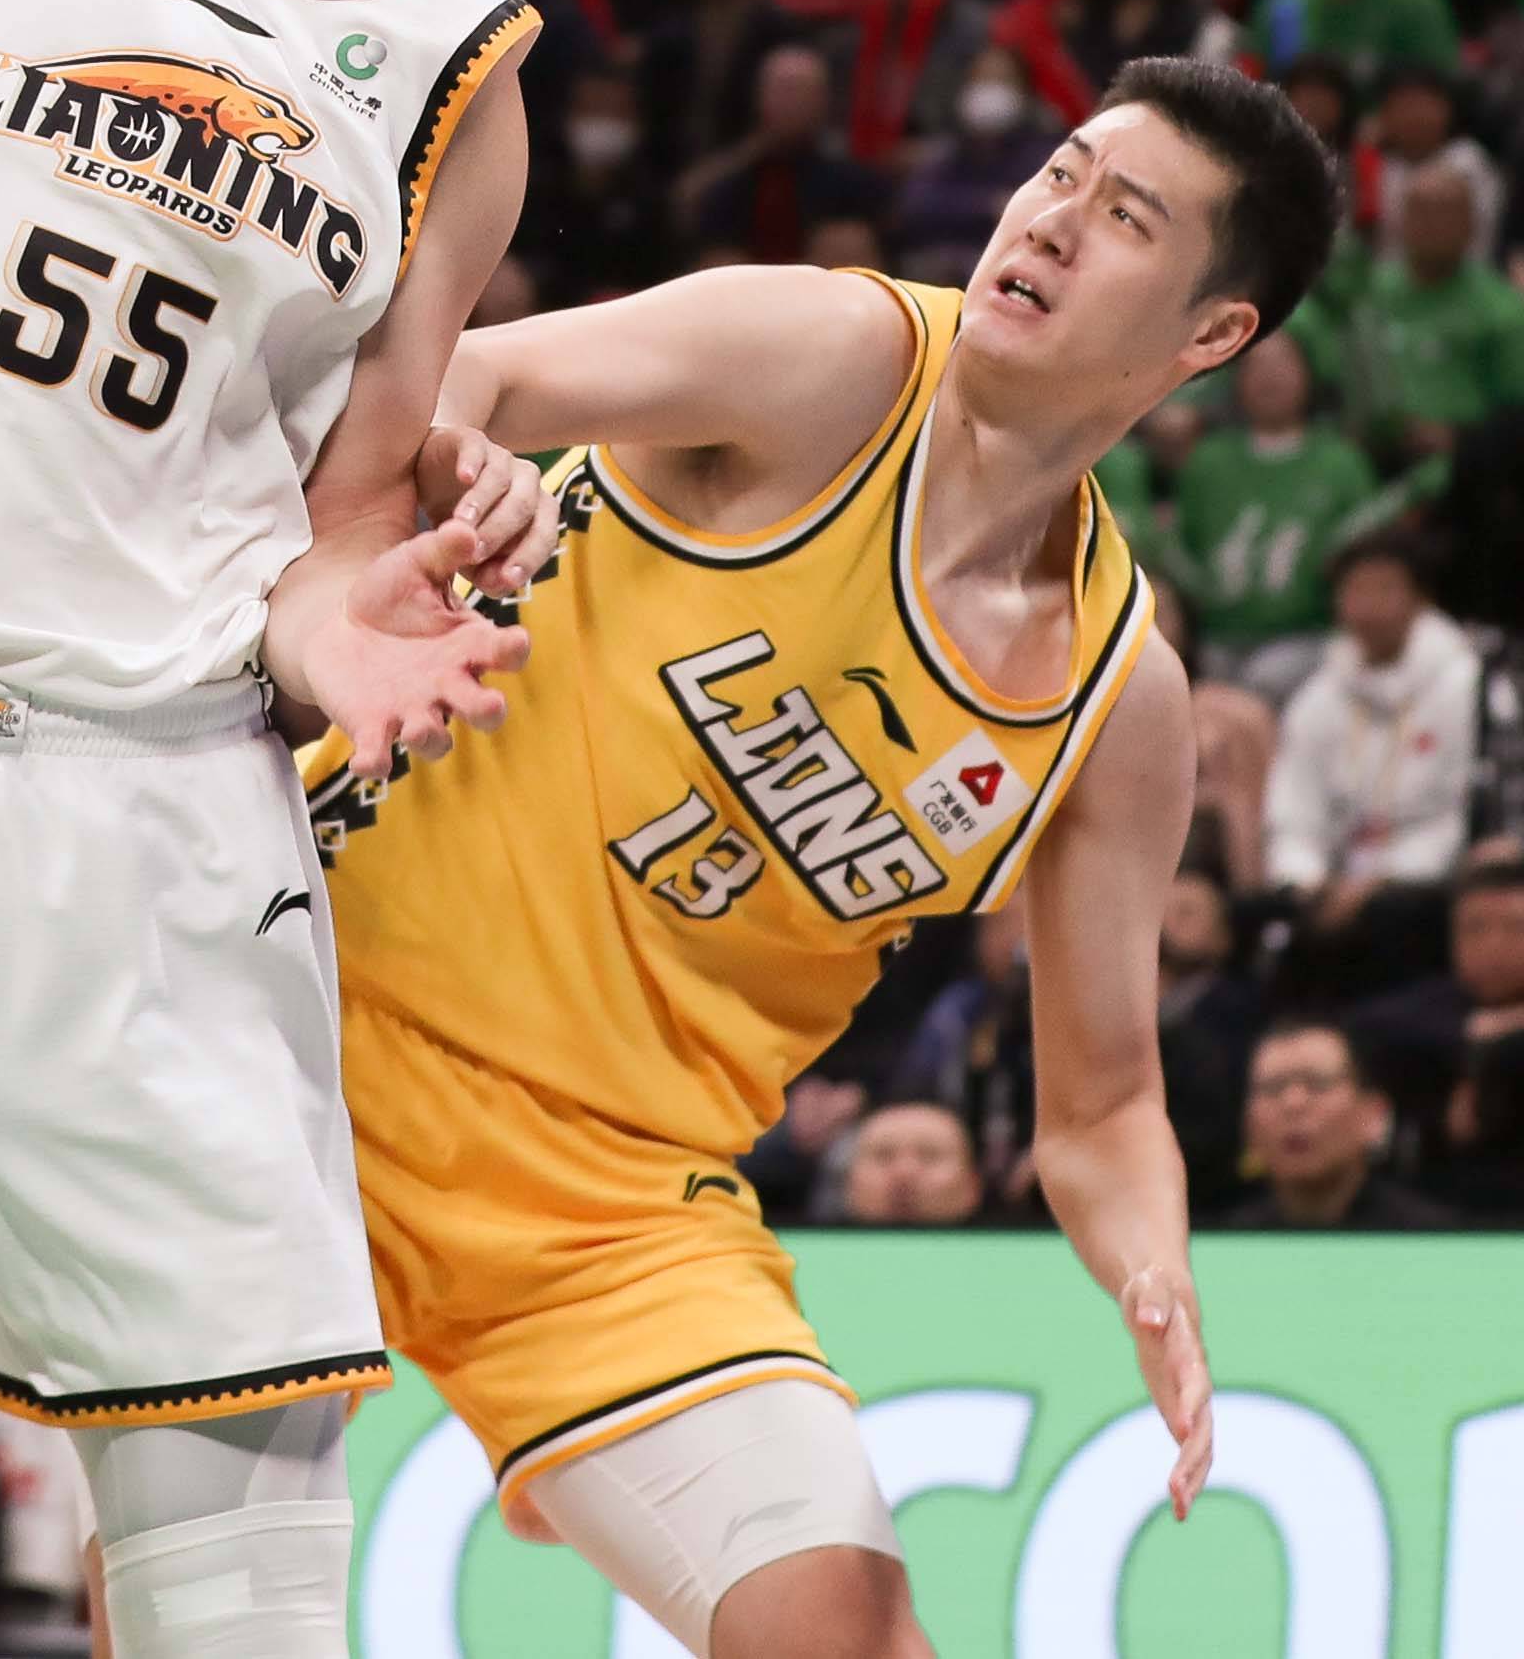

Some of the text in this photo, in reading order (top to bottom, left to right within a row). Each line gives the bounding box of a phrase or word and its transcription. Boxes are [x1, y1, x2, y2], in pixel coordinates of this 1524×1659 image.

[309, 73, 377, 121] CHINA LIFE
[61, 152, 238, 239] LEOPARDS
[658, 629, 949, 922] LIONS
[923, 802, 953, 835] CGB
[606, 784, 767, 920] 13
